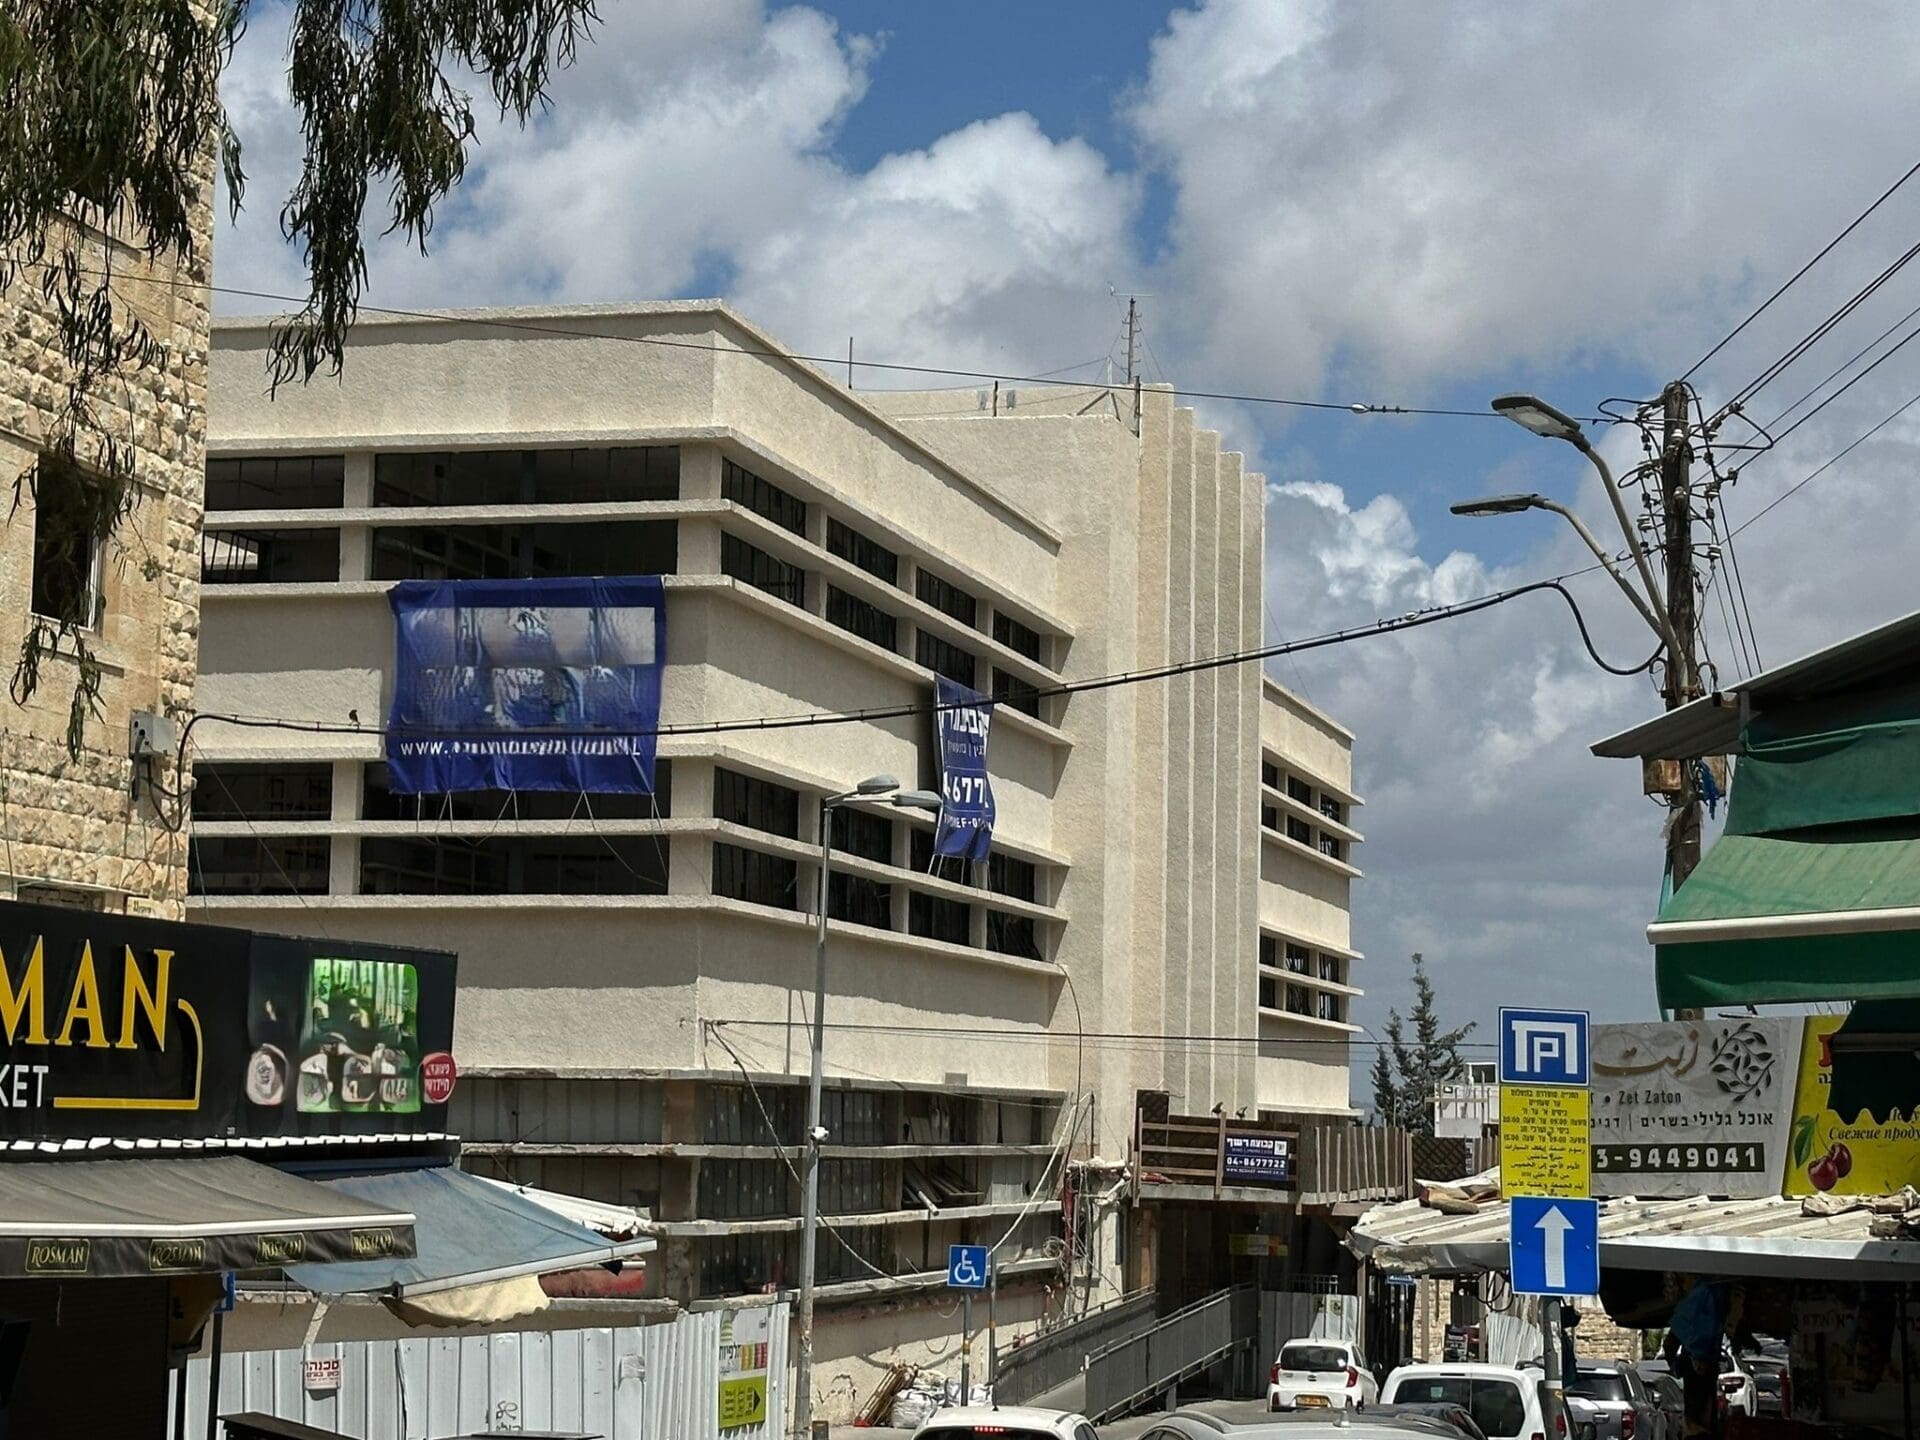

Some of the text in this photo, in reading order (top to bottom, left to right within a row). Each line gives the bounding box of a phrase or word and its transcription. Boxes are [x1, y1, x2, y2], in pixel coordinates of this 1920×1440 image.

[1619, 1090, 1681, 1104] Zet Zaton
[1641, 1117, 1689, 1127] בשרים
[1694, 1111, 1732, 1126] גלילי
[1738, 1110, 1773, 1126] אוכל
[1829, 1126, 1880, 1140] Свежие
[1227, 1138, 1249, 1147] רשף
[31, 1246, 85, 1267] ROSMAN
